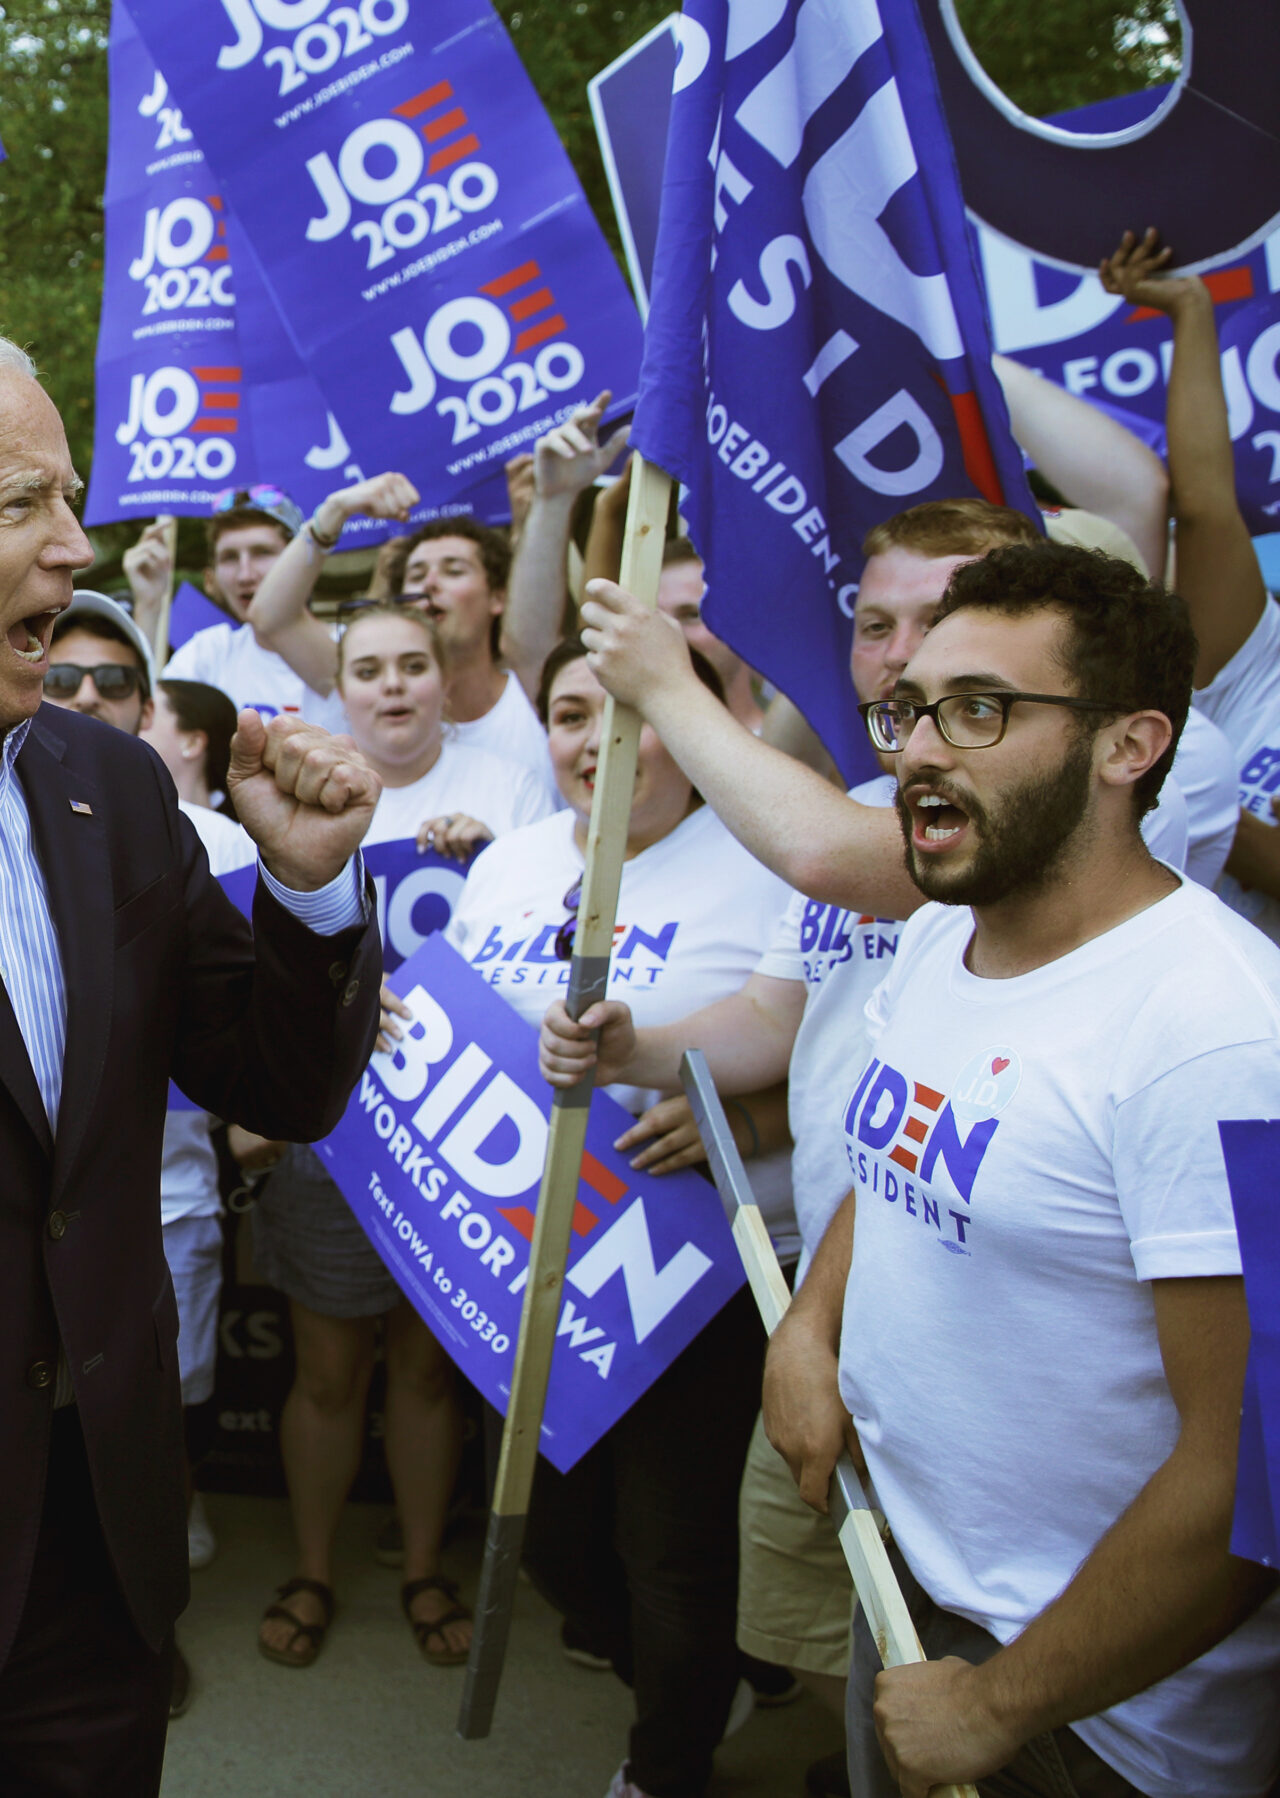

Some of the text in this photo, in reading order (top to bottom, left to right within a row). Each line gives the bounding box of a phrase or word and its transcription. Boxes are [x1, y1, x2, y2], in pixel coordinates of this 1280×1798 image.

[263, 0, 409, 96] 2020
[305, 79, 481, 242] JOE
[351, 162, 498, 271] 2020
[389, 259, 567, 415] JOE
[437, 342, 585, 446] 2020
[1062, 340, 1174, 397] FO
[115, 366, 242, 445] JOE
[127, 436, 236, 483] 2020
[706, 393, 860, 619] OEBIDEN.C
[844, 1057, 1000, 1206] IDEN
[360, 1070, 449, 1203] WORKS
[439, 1190, 516, 1279] FOR
[507, 1265, 617, 1381] IWA
[368, 1171, 511, 1355] Text IOWA to 30330
